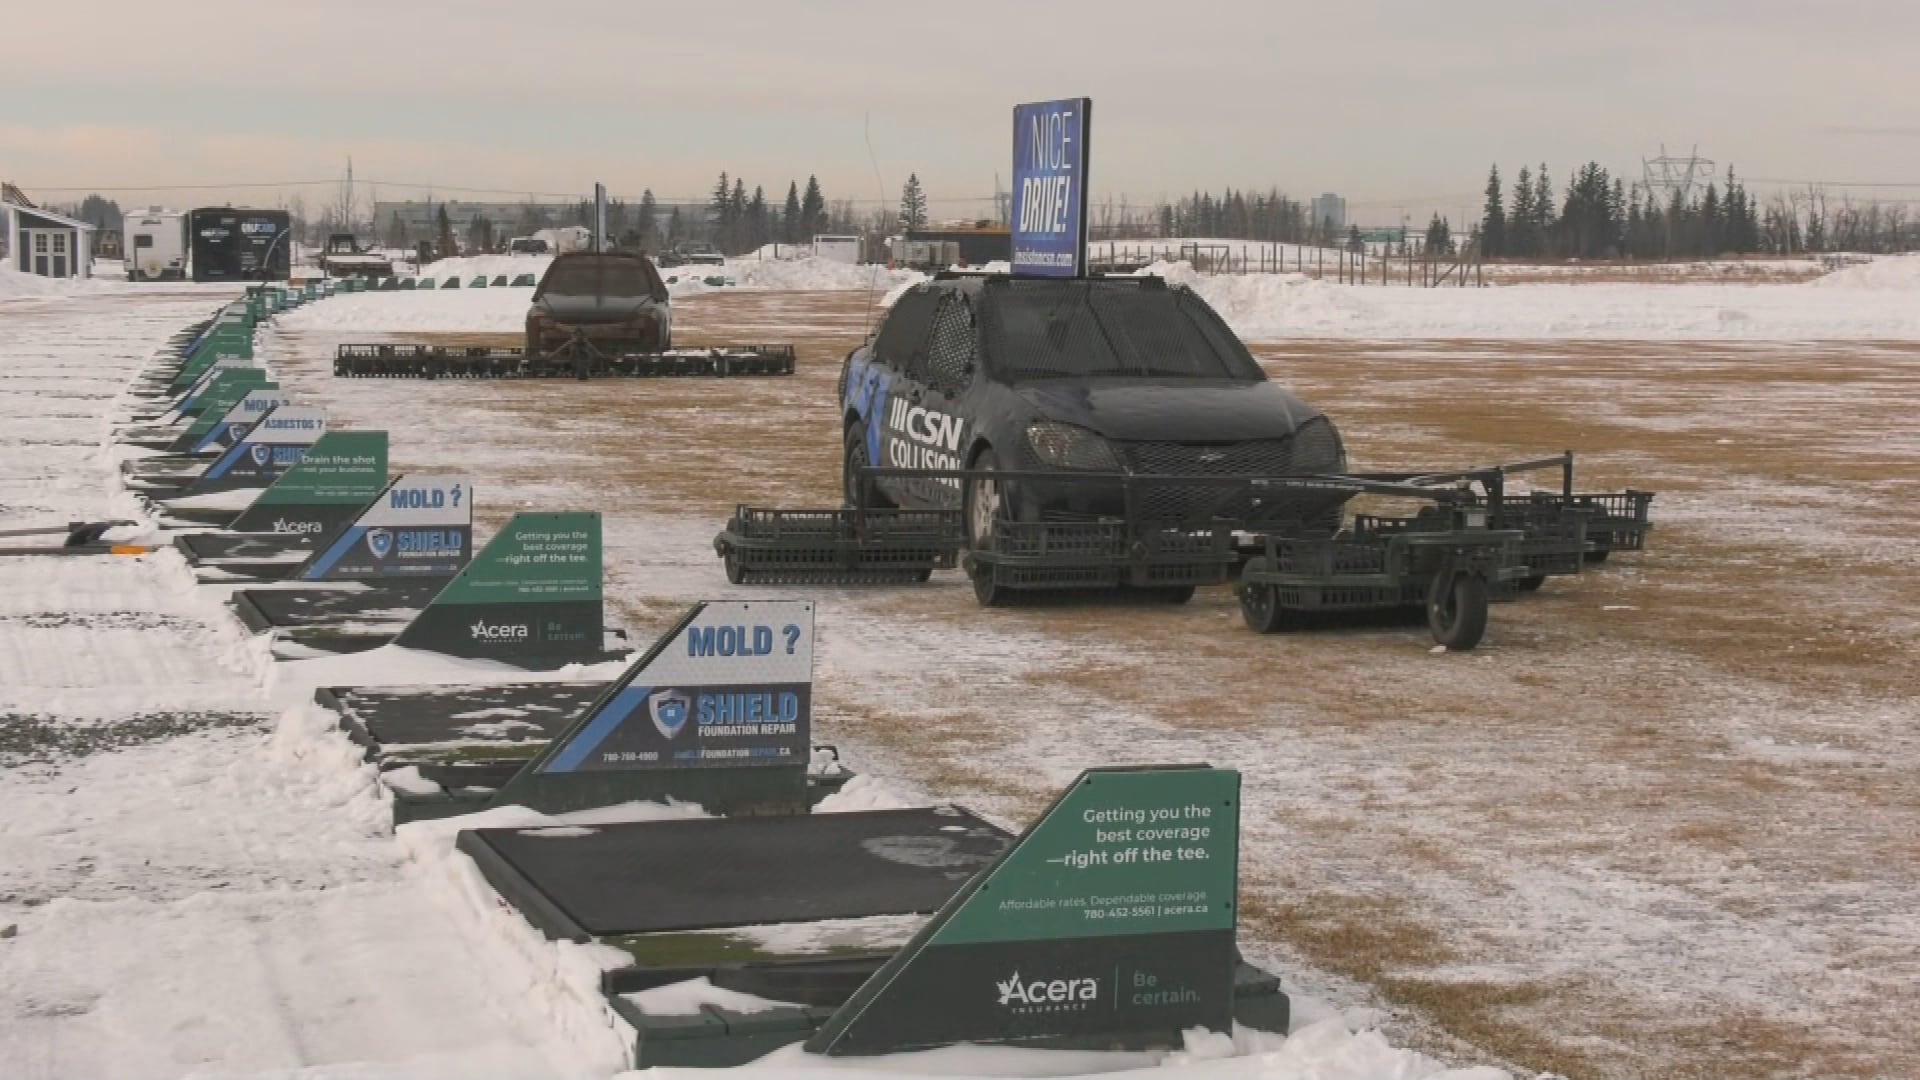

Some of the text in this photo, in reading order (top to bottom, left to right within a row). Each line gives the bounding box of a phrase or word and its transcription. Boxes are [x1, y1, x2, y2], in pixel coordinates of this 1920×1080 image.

[1032, 111, 1073, 171] NICE
[1019, 175, 1071, 233] DRIVE!
[264, 419, 314, 429] ASBESTOS
[301, 455, 376, 465] Drain the shot
[890, 437, 961, 489] COLLISION
[390, 484, 462, 508] MOLD ?
[273, 517, 322, 533] Acera
[397, 531, 462, 551] SHIELD
[515, 531, 588, 542] Getting you the
[523, 542, 588, 552] best coverage
[532, 554, 548, 563] off
[549, 554, 567, 563] the
[470, 619, 528, 639] Acera
[688, 623, 800, 657] MOLD ?
[696, 691, 798, 725] SHIELD
[698, 723, 796, 737] FOUNDATION REPAIR
[1083, 803, 1212, 825] Getting you the
[1096, 826, 1211, 843] best coverage
[1112, 847, 1139, 864] off
[1142, 846, 1173, 863] the
[1177, 845, 1210, 861] tee.
[999, 898, 1057, 911] Affordable
[1090, 893, 1156, 906] Dependable
[1163, 903, 1209, 915] acera.ca
[996, 970, 1098, 1005] Acera
[1133, 970, 1158, 987] Be
[1132, 986, 1201, 1005] certain.
[1011, 1003, 1087, 1014] INSURANCE
